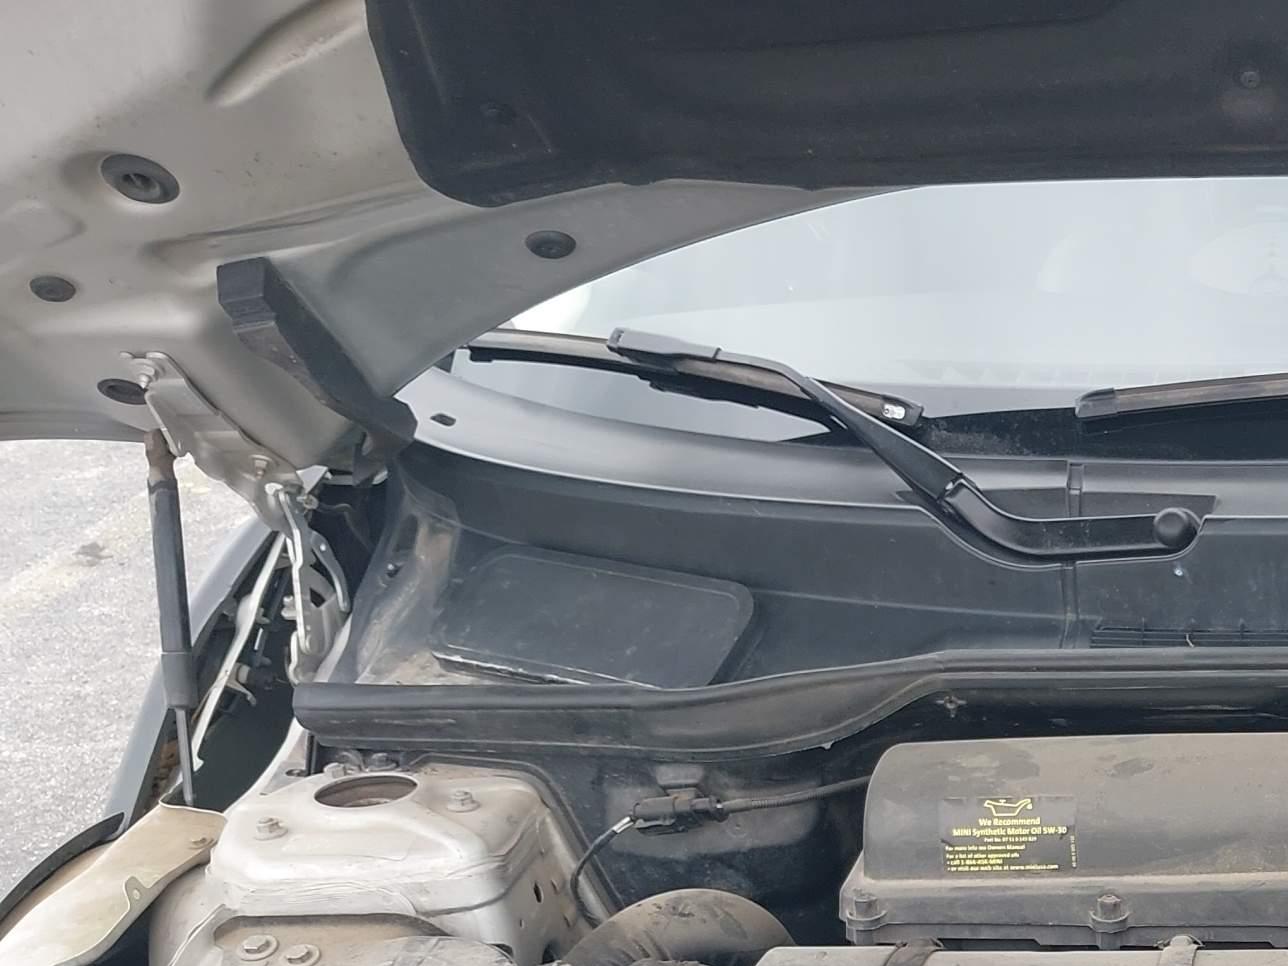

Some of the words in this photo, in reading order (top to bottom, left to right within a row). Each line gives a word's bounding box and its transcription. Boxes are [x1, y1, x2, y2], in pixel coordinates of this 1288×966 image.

[979, 818, 993, 826] We
[994, 817, 1040, 826] Recommend
[972, 827, 1006, 838] Synthetic
[1007, 827, 1030, 836] Motor
[1031, 826, 1042, 834] Oil
[1042, 826, 1067, 834] 5W-30
